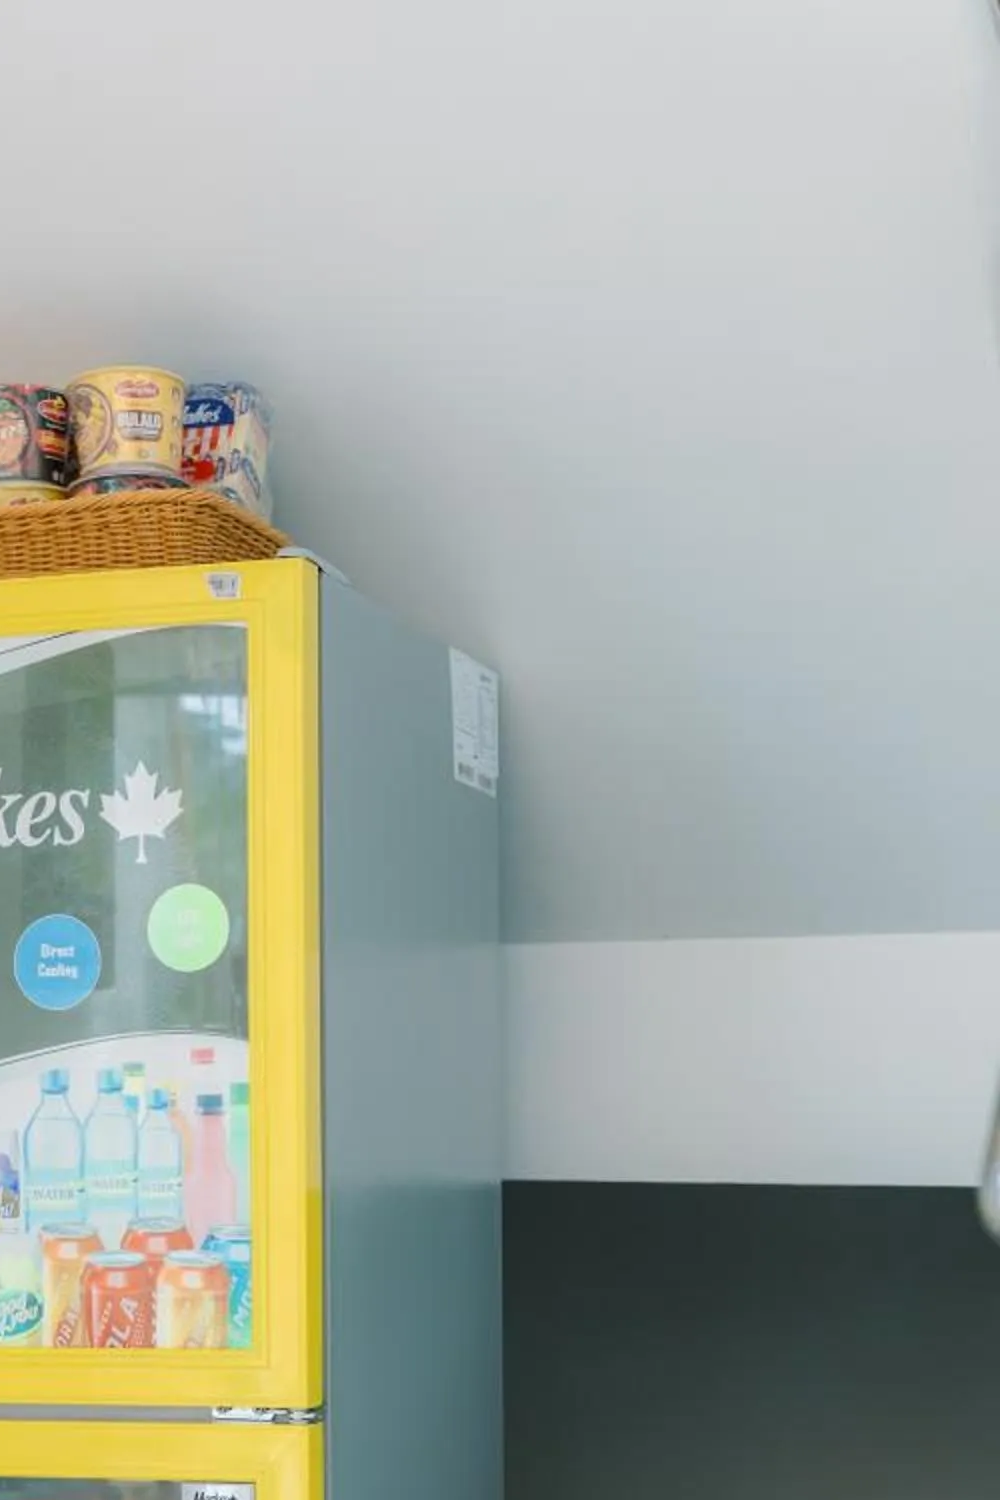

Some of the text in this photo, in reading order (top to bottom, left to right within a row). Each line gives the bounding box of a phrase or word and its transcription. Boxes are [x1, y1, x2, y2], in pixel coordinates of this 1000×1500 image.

[40, 944, 75, 959] Direct
[37, 963, 79, 979] Cooling
[32, 1186, 74, 1201] WATER
